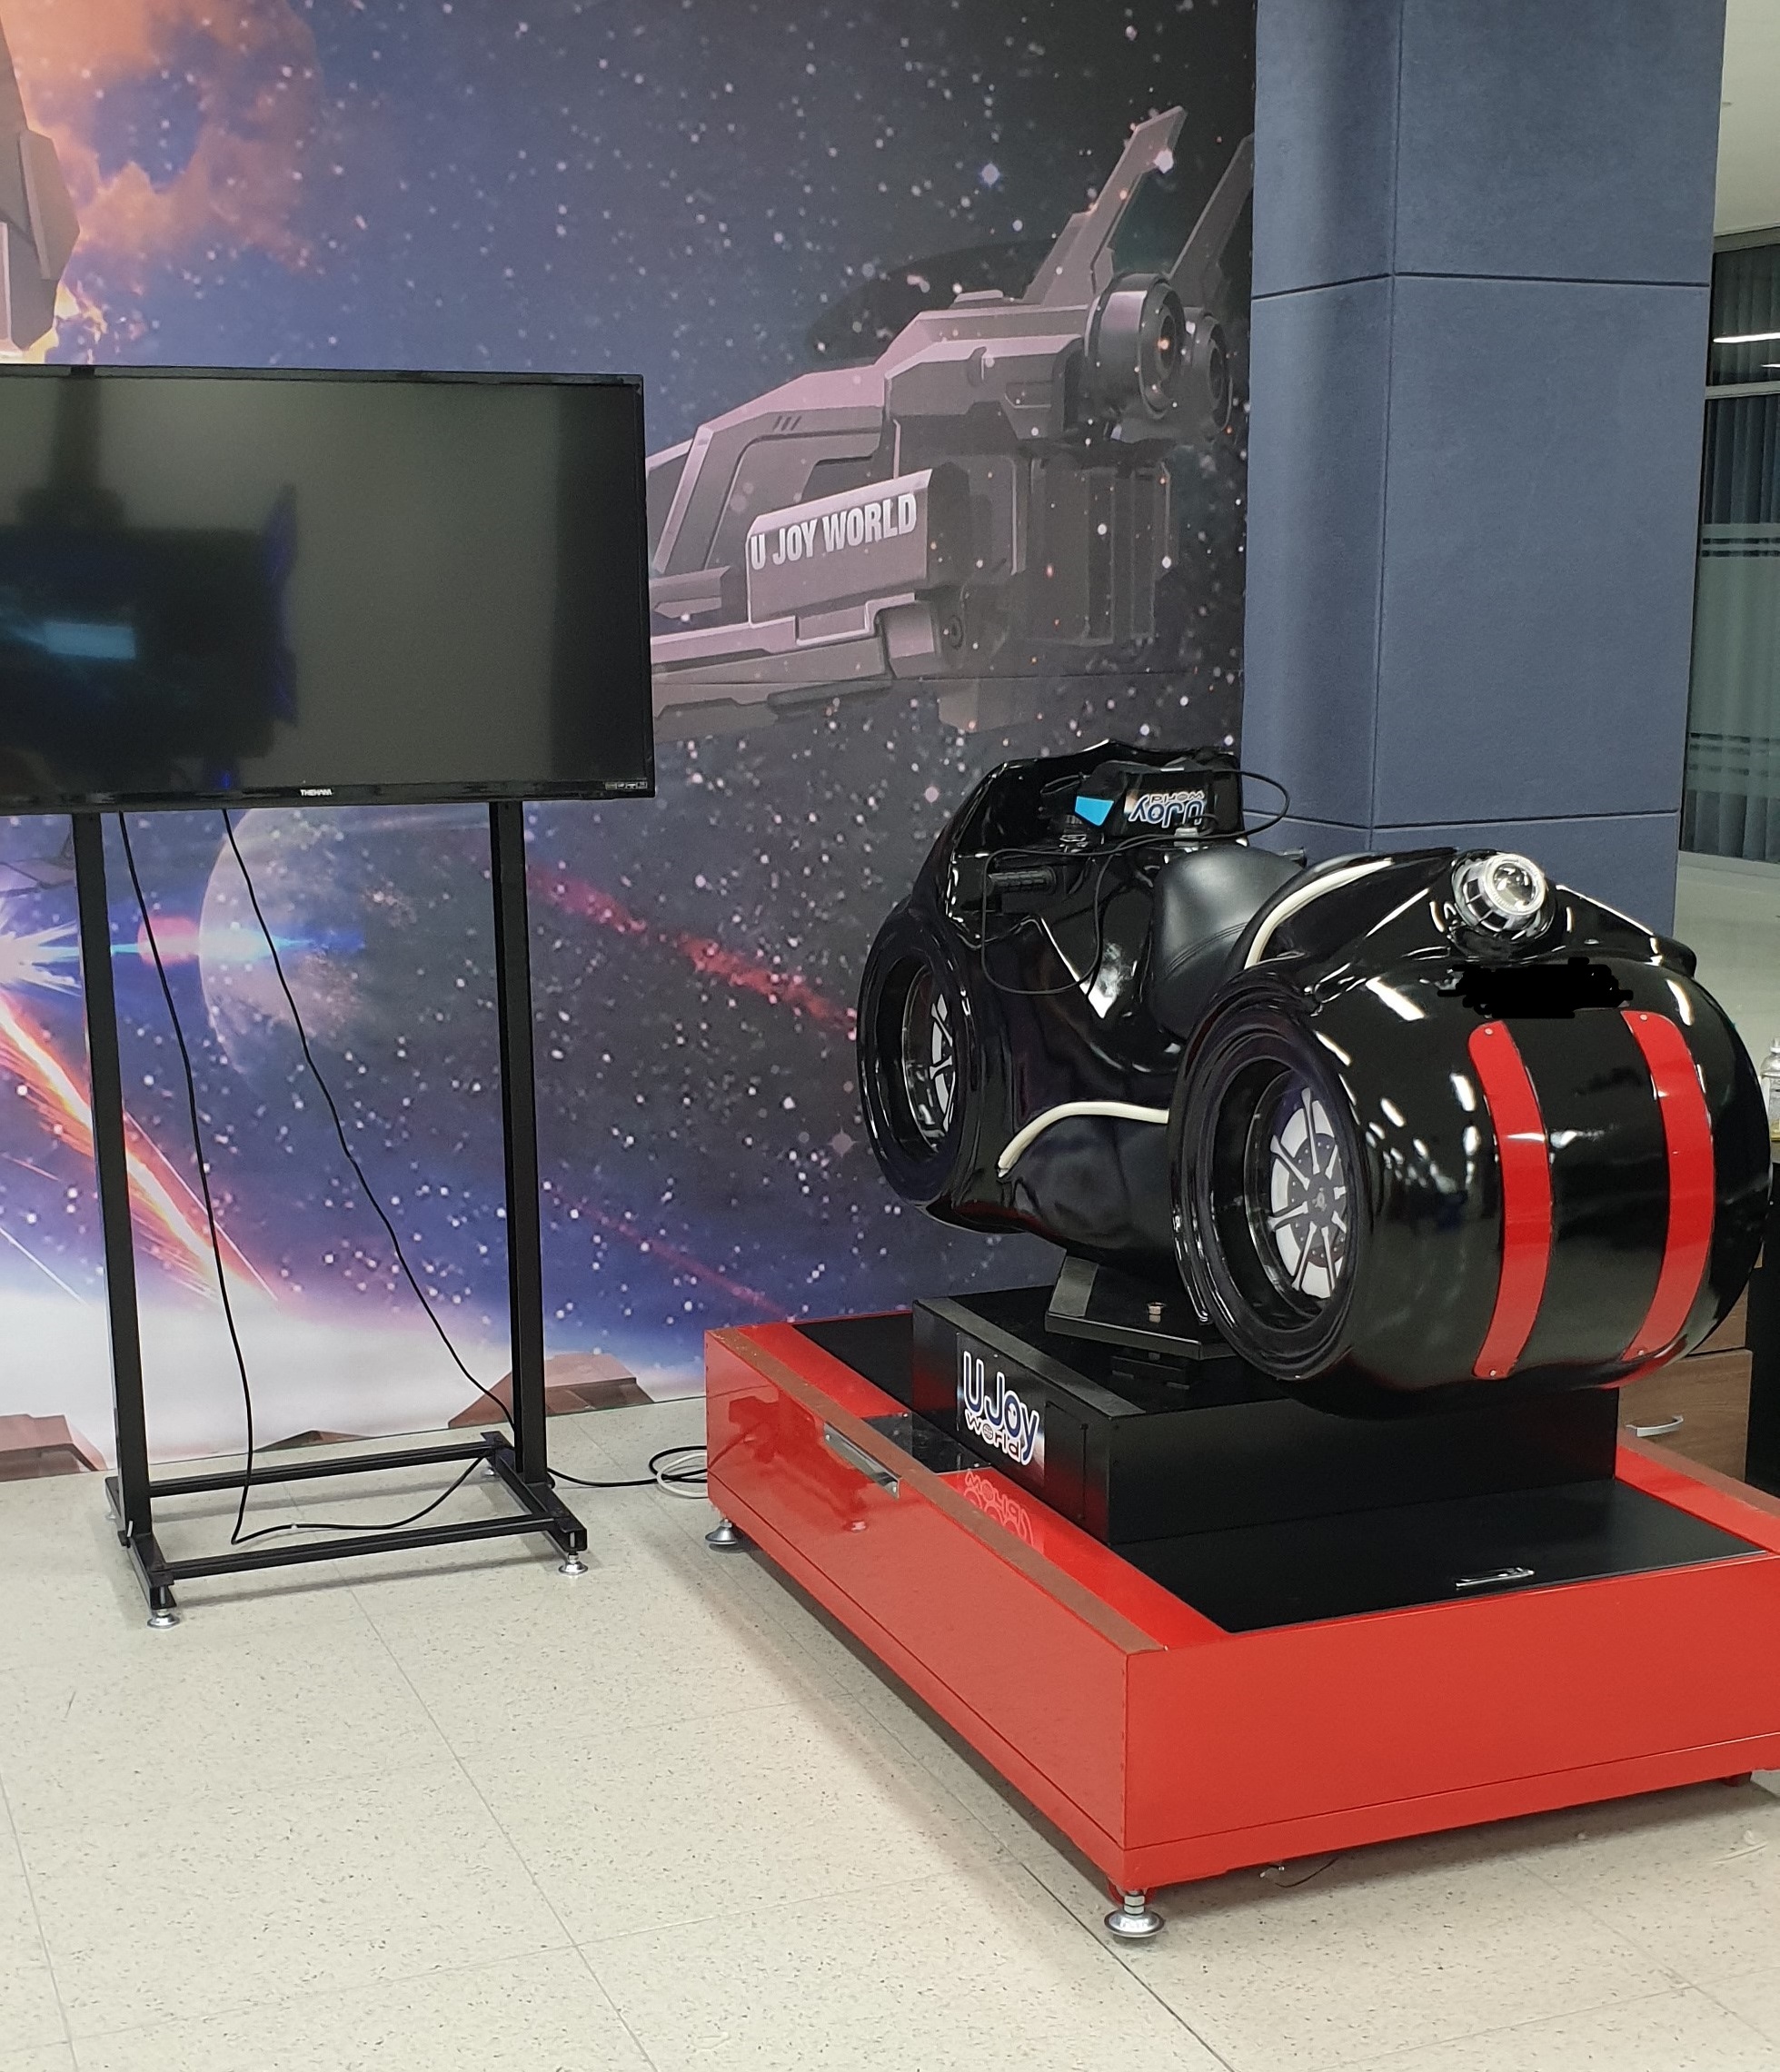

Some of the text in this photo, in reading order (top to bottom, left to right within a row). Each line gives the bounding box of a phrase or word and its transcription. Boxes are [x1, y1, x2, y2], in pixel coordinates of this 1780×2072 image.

[751, 493, 917, 570] U JOY WORLD
